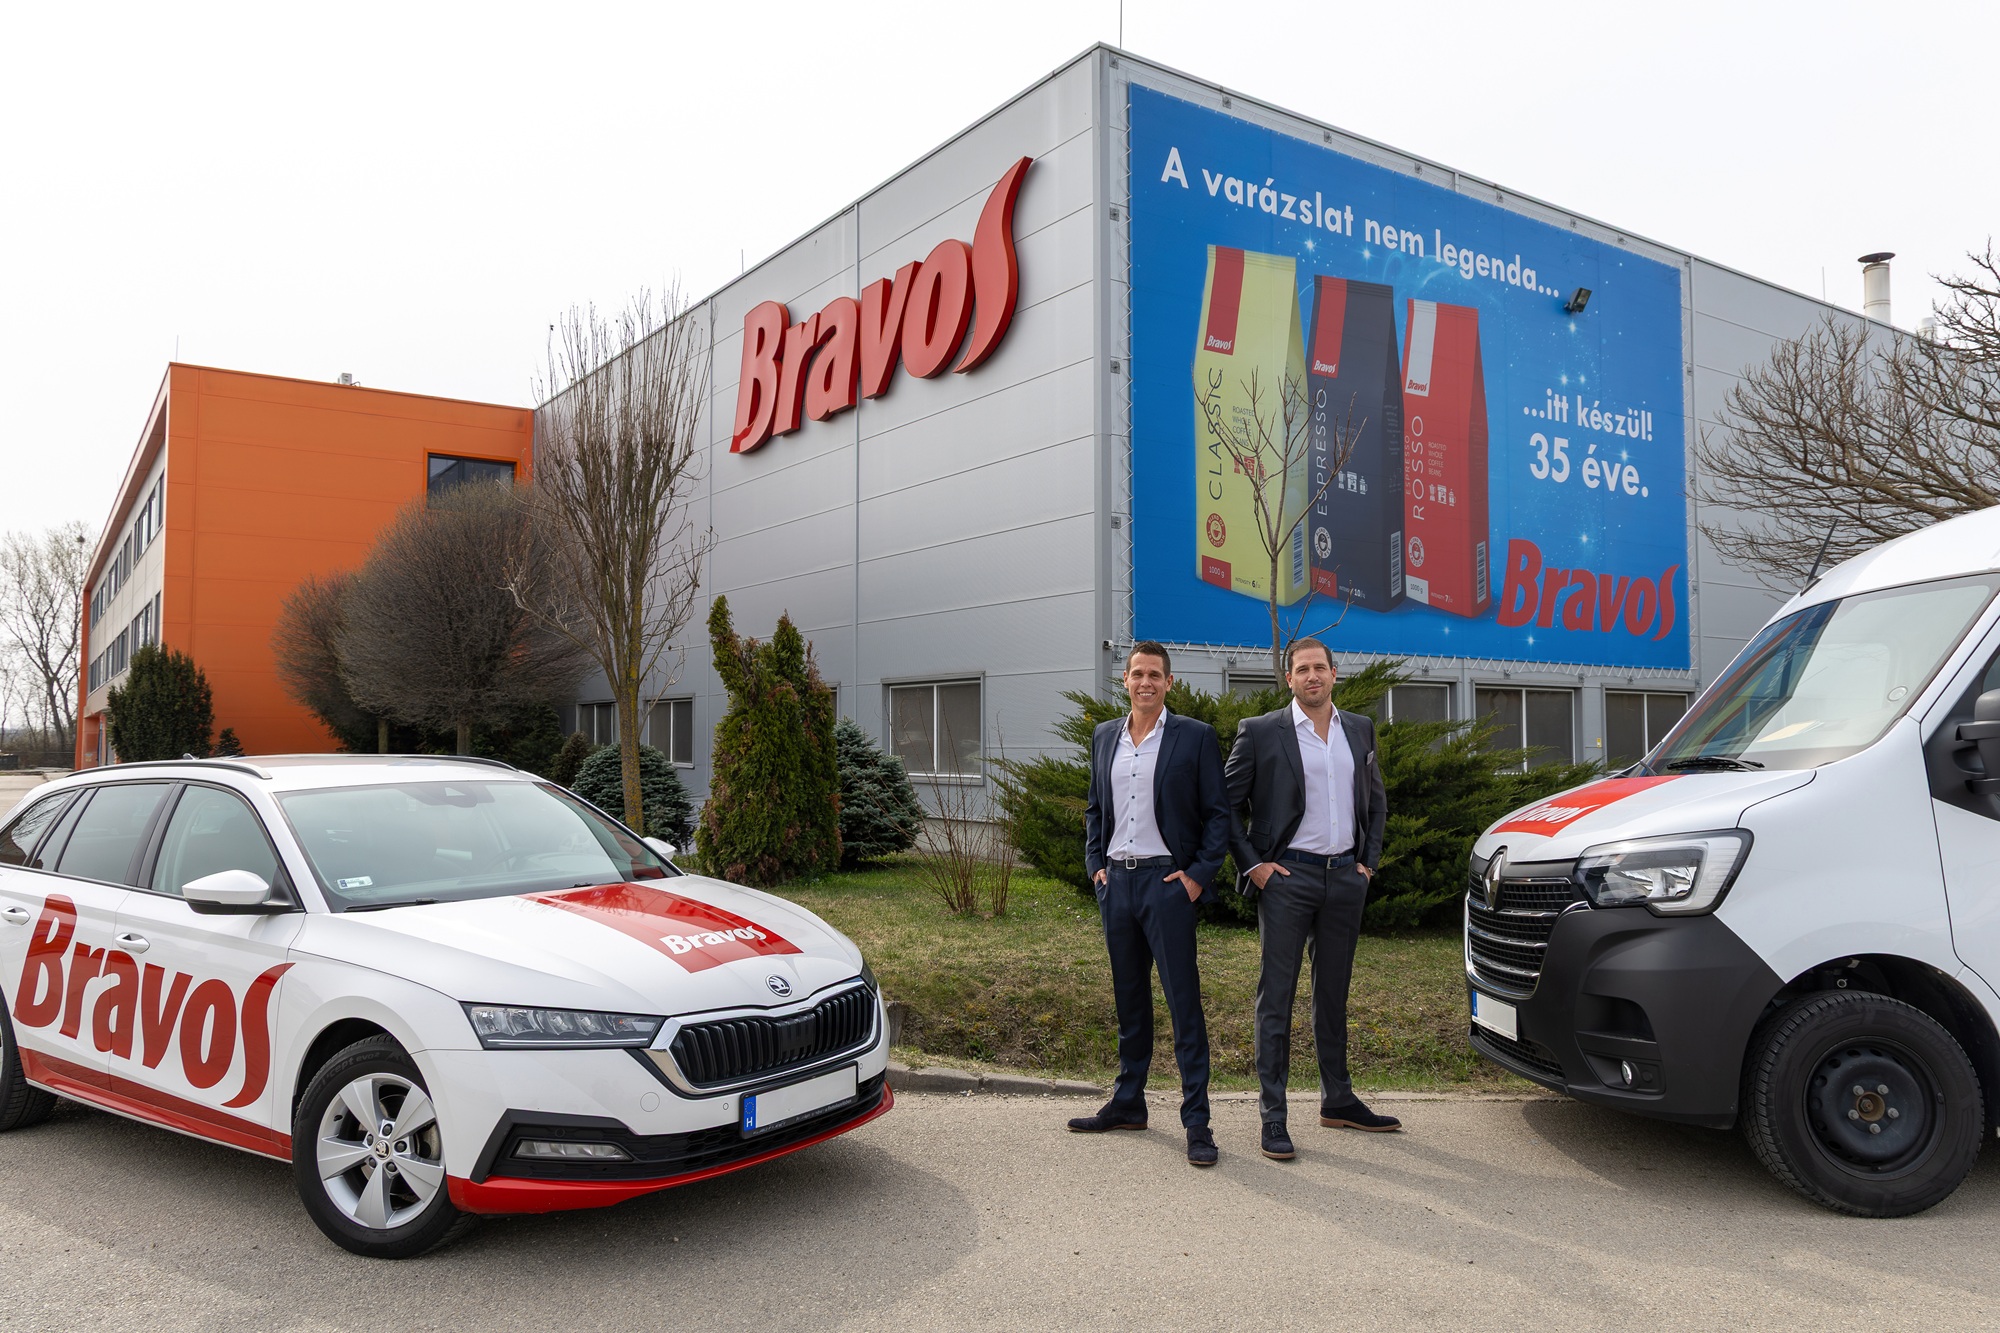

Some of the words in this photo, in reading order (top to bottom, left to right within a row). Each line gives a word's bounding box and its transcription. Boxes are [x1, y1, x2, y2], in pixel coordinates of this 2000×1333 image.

[1161, 146, 1189, 189] A
[1202, 168, 1354, 237] varázslat
[1365, 218, 1424, 258] nem
[729, 156, 1034, 454] Bravos
[1207, 335, 1232, 350] Bravos
[1314, 360, 1336, 374] Bravos
[1407, 380, 1428, 392] Bravos
[1232, 416, 1251, 426] WHOE
[1577, 395, 1653, 442] készül!
[1208, 367, 1222, 500] CLASSIC
[1316, 388, 1328, 516] ESPRESSO
[1428, 441, 1447, 451] ROASTED
[1428, 450, 1443, 460] WHOLE
[1411, 415, 1425, 520] ROSSO
[1428, 459, 1444, 468] COFFEE
[1428, 467, 1442, 478] BEANS
[1529, 432, 1570, 483] 35
[1582, 444, 1649, 498] éve.
[1209, 566, 1221, 575] 1000
[1496, 538, 1681, 641] Bravos
[660, 925, 767, 955] Bravos
[12, 893, 296, 1108] Bravos
[746, 1116, 753, 1128] H
